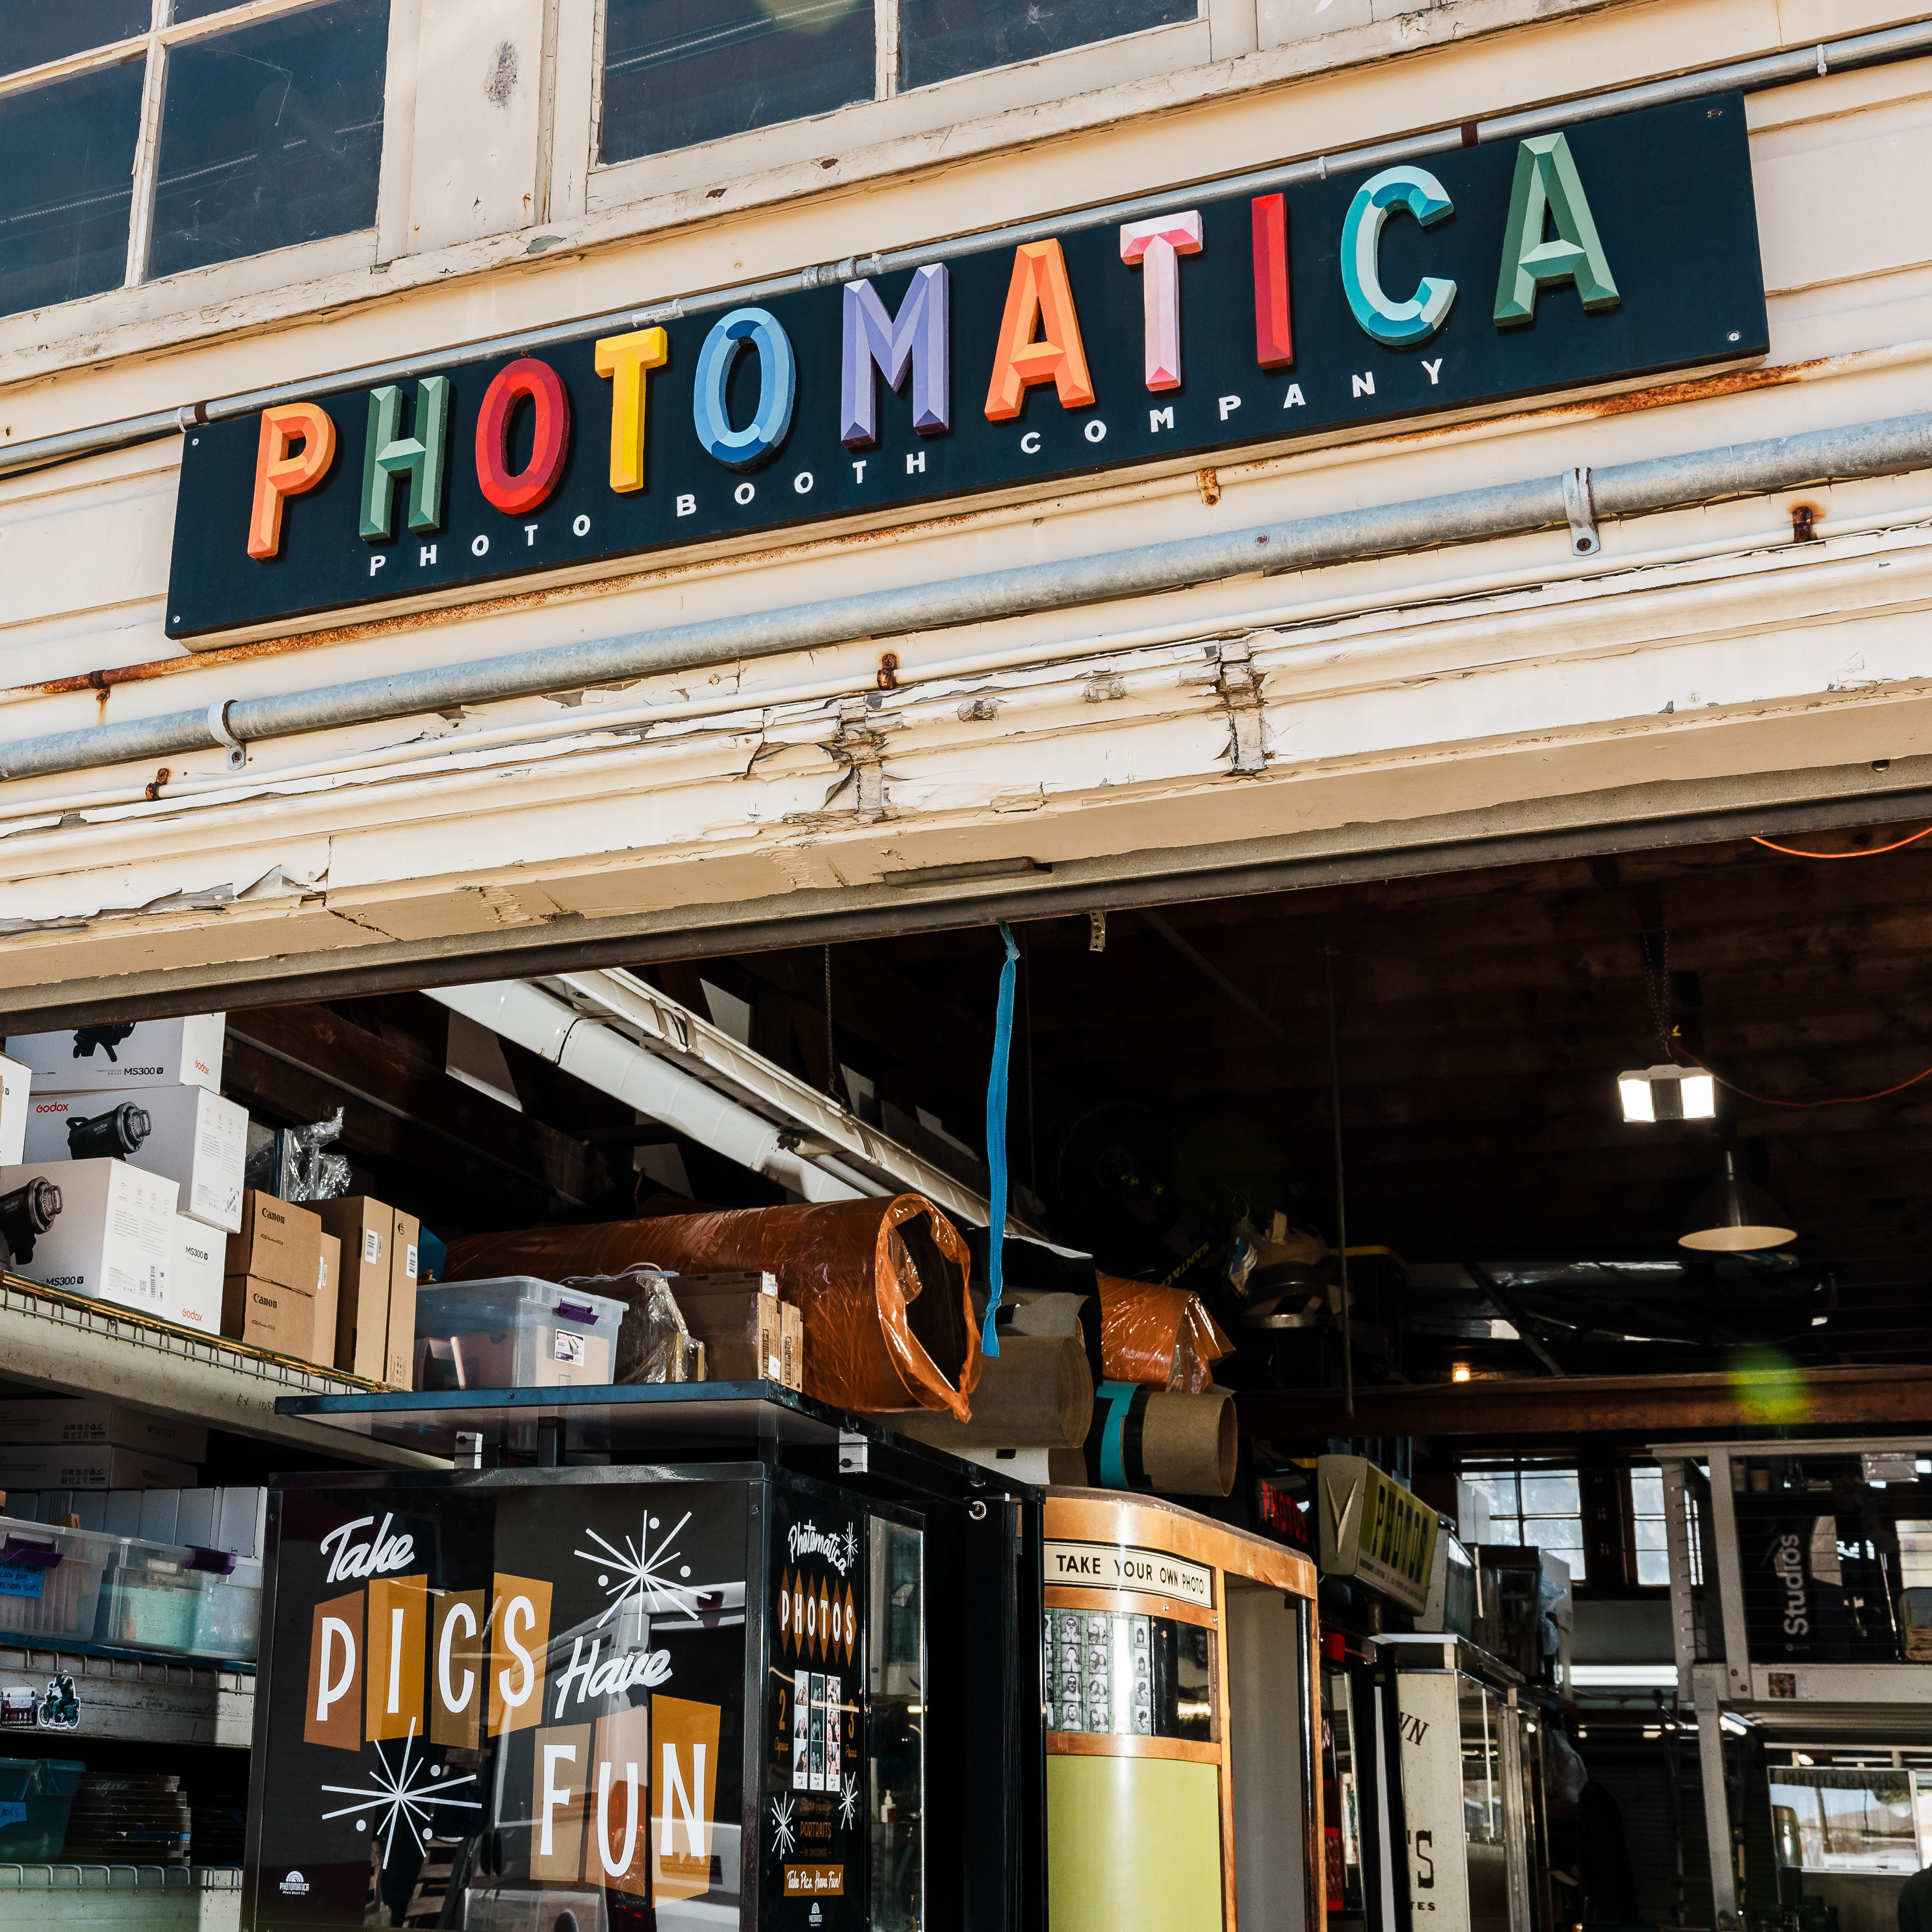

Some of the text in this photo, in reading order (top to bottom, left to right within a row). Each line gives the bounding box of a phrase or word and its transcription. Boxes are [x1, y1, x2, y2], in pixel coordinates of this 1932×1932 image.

[247, 131, 1621, 559] PHOTOMATICA
[369, 358, 1443, 576] PHOTO BOOTH COMPANY
[124, 1067, 155, 1076] MS300
[195, 1060, 209, 1076] Godox
[36, 1102, 69, 1113] Godox
[262, 1207, 285, 1224] Canon
[186, 1246, 204, 1259] MS300
[46, 1276, 75, 1286] MS300
[182, 1308, 203, 1323] Godox
[253, 1293, 277, 1309] Canon
[147, 1424, 177, 1439] WIMAXIT
[141, 1469, 169, 1483] WIMAXIT
[321, 1512, 415, 1583] Take
[788, 1519, 847, 1577] Photomatica
[1372, 1484, 1429, 1584] PHOTOS
[1056, 1555, 1204, 1594] TAKE YOUR OWN PHOTO
[1780, 1535, 1809, 1636] Studios
[781, 1590, 853, 1645] PHOTOS
[316, 1595, 537, 1722] PICS
[555, 1636, 673, 1720] Have
[779, 1688, 786, 1730] 2
[848, 1698, 854, 1739] 3
[539, 1743, 707, 1878] FUN
[799, 1821, 832, 1838] PORTRAITS
[279, 1882, 310, 1891] PHOTOMATICA
[787, 1870, 800, 1889] Take
[815, 1870, 828, 1892] Have
[828, 1871, 841, 1889] Fun!
